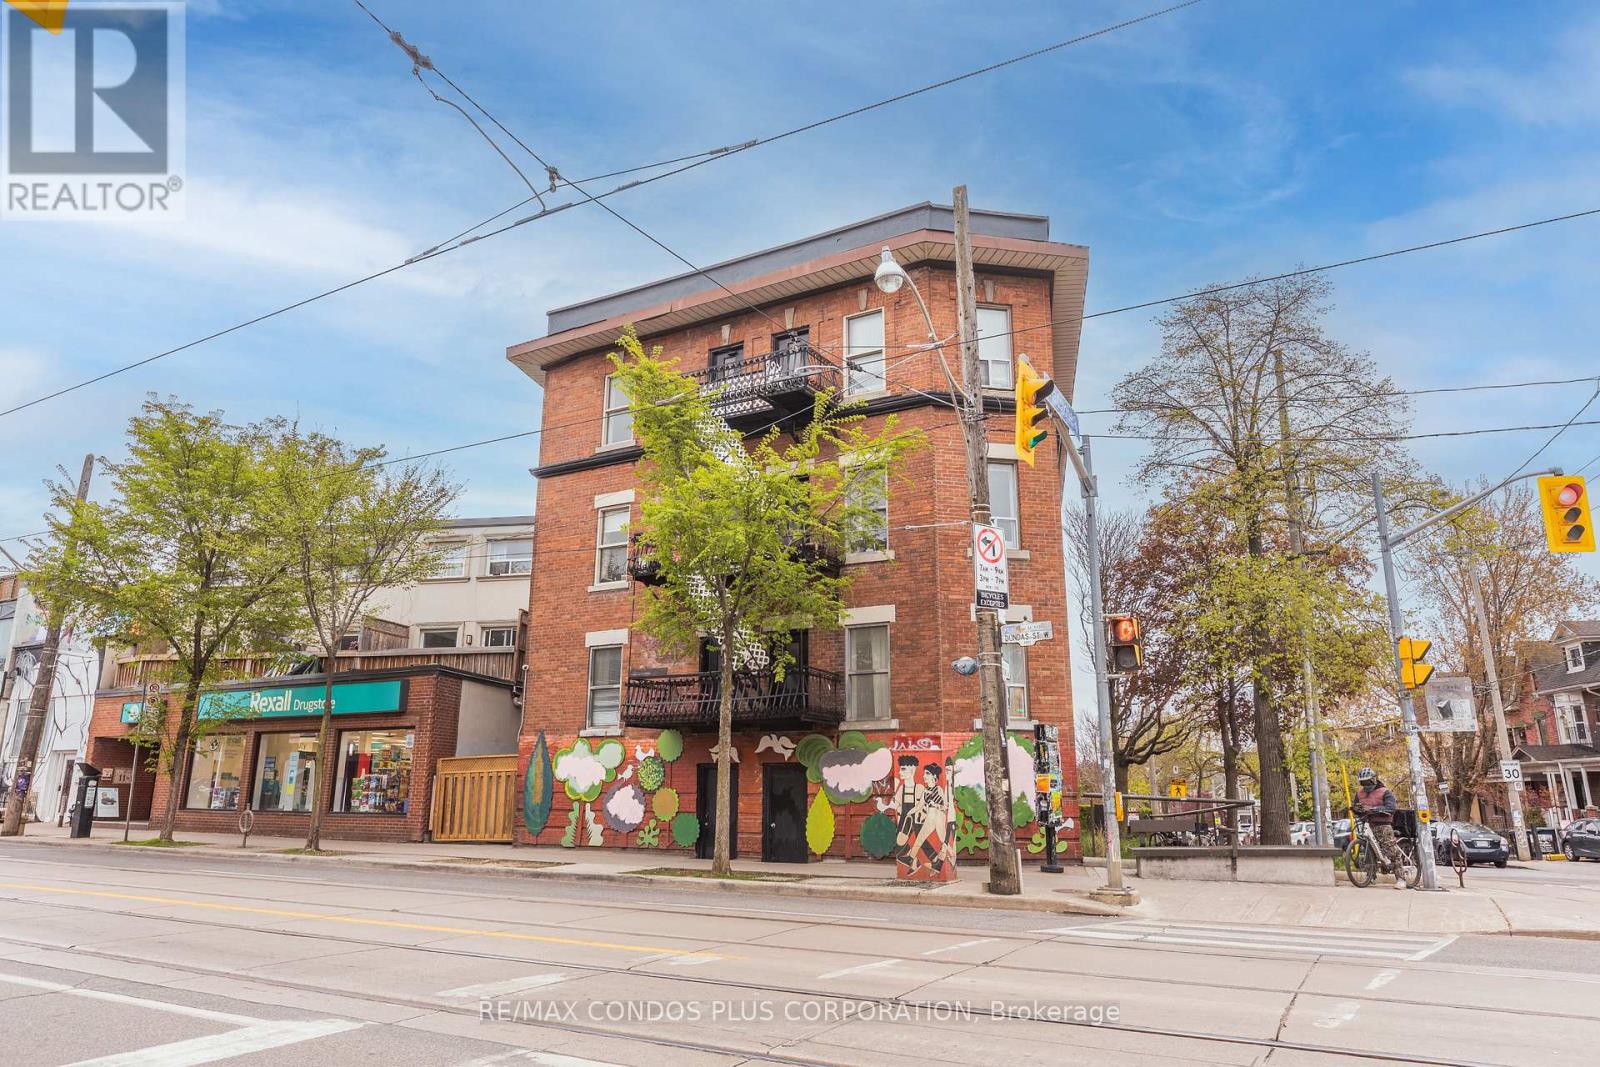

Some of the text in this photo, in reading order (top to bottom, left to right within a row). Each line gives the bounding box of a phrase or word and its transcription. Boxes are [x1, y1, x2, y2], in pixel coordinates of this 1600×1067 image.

[981, 592, 1004, 600] BICYCLES
[980, 600, 1005, 608] EXCEPTED
[1004, 632, 1029, 641] DUNDAS
[250, 690, 336, 713] Rexall Drugstoe
[1504, 768, 1520, 779] 30
